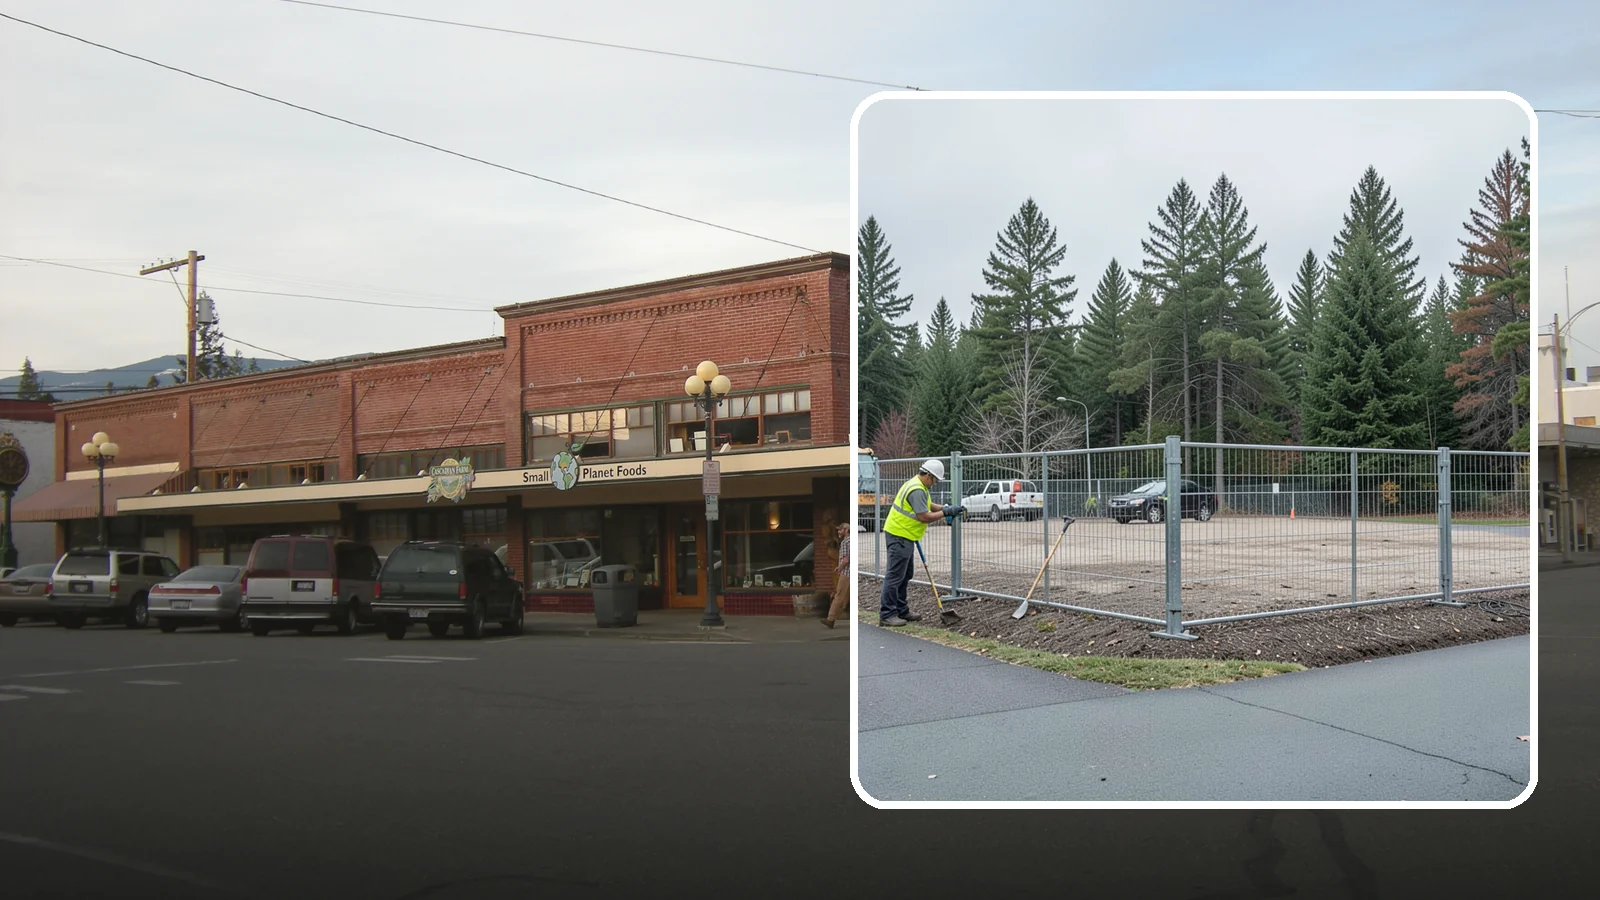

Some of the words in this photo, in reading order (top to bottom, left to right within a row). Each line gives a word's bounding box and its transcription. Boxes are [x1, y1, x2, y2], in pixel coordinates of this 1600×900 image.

[523, 471, 549, 483] Small
[583, 468, 614, 479] Planet
[617, 464, 647, 477] Foods
